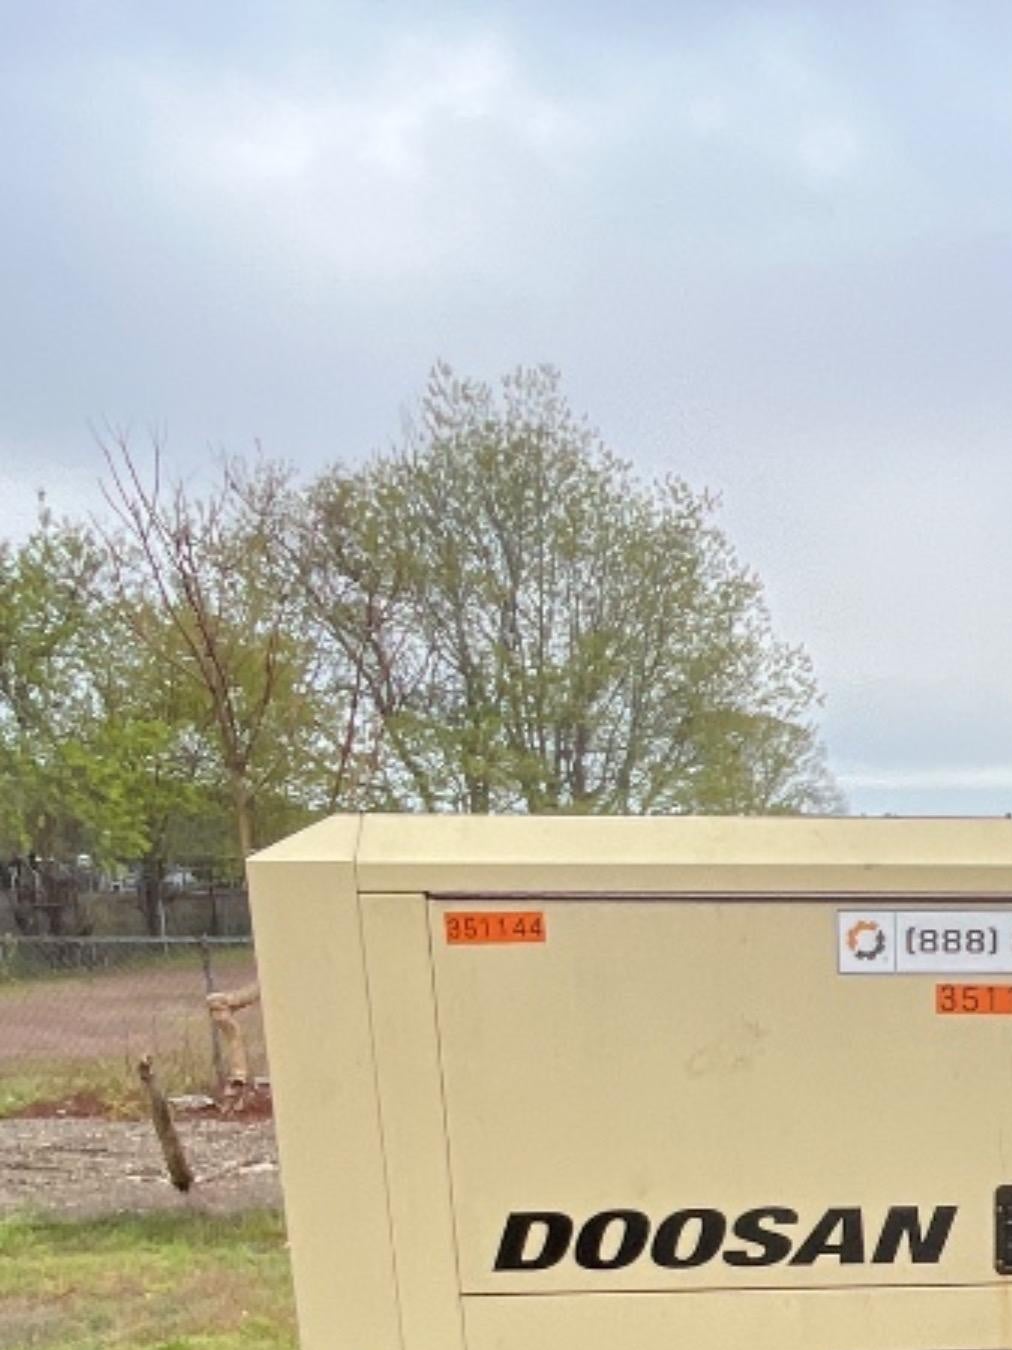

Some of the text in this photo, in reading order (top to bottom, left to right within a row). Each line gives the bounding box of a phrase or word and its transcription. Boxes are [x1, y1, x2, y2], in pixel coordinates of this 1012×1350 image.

[447, 917, 543, 939] 351144
[905, 927, 998, 955] (888)
[493, 1205, 957, 1272] DOOSAN
